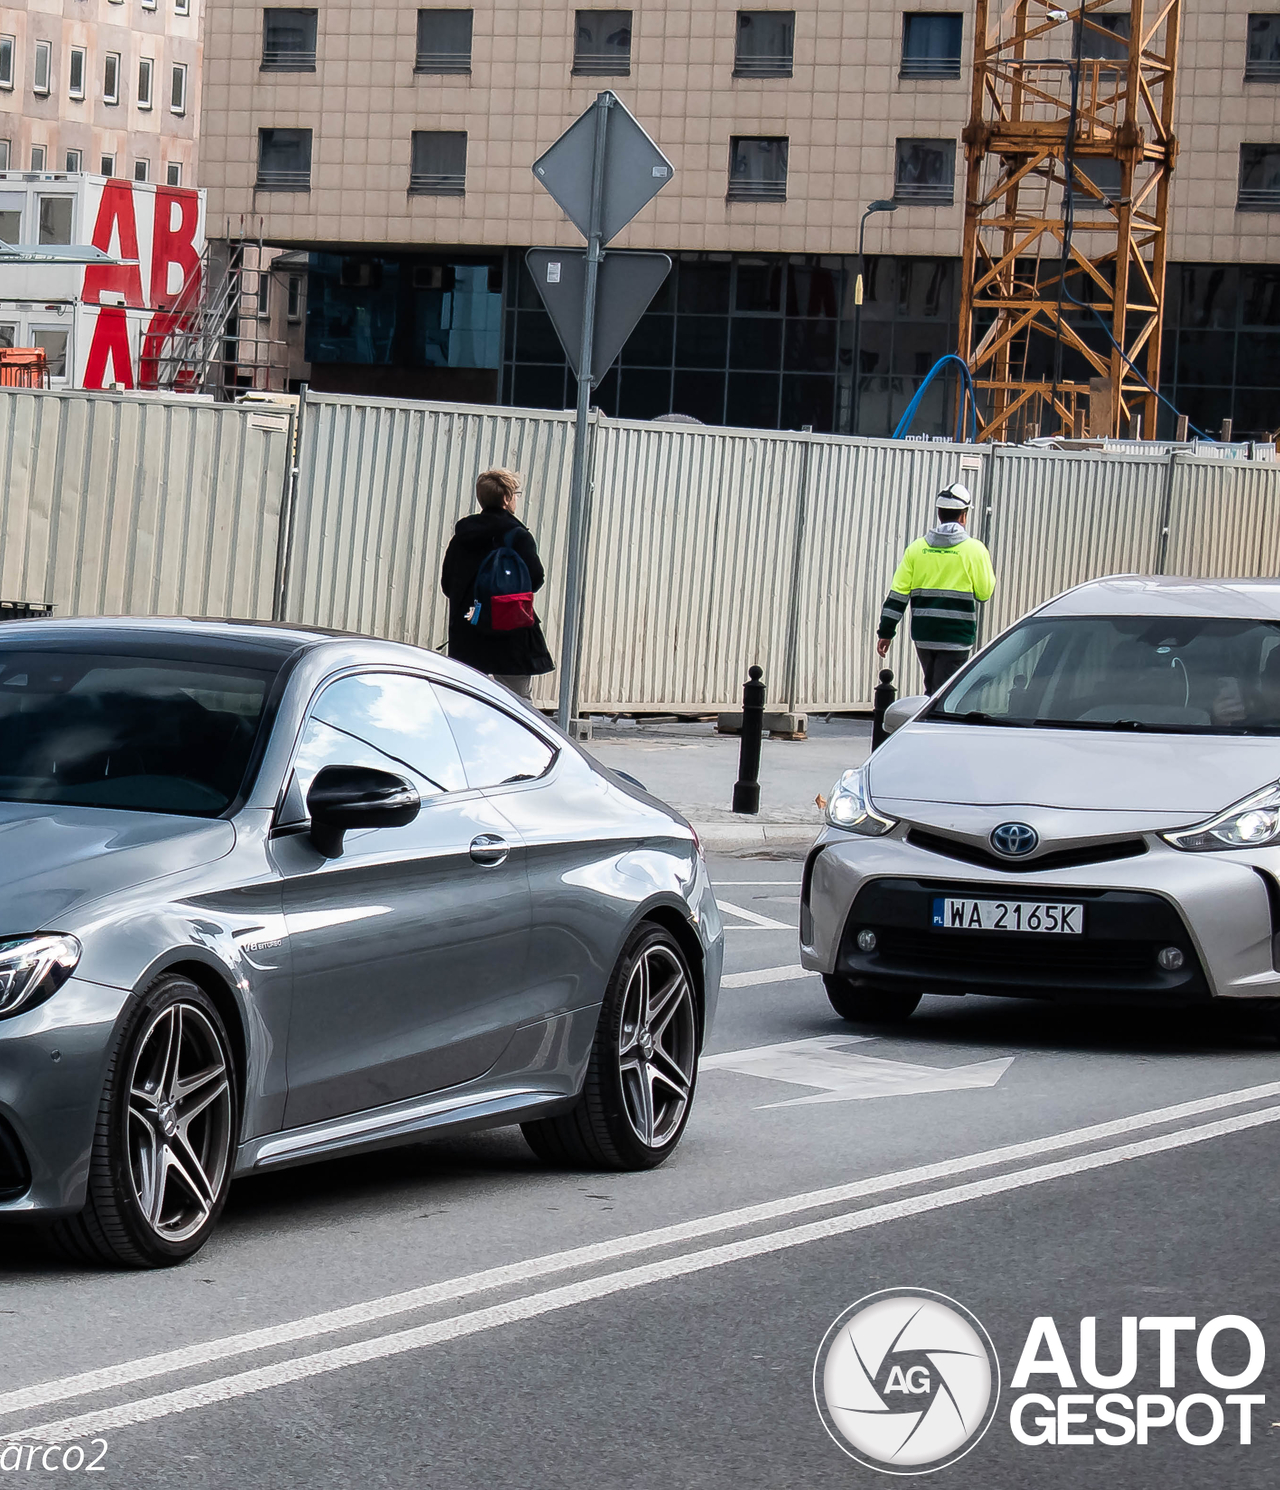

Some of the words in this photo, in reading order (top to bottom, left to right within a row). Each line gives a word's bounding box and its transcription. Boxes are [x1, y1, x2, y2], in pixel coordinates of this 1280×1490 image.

[933, 916, 943, 924] PL
[950, 900, 982, 928] WA
[993, 903, 1077, 933] 2165K
